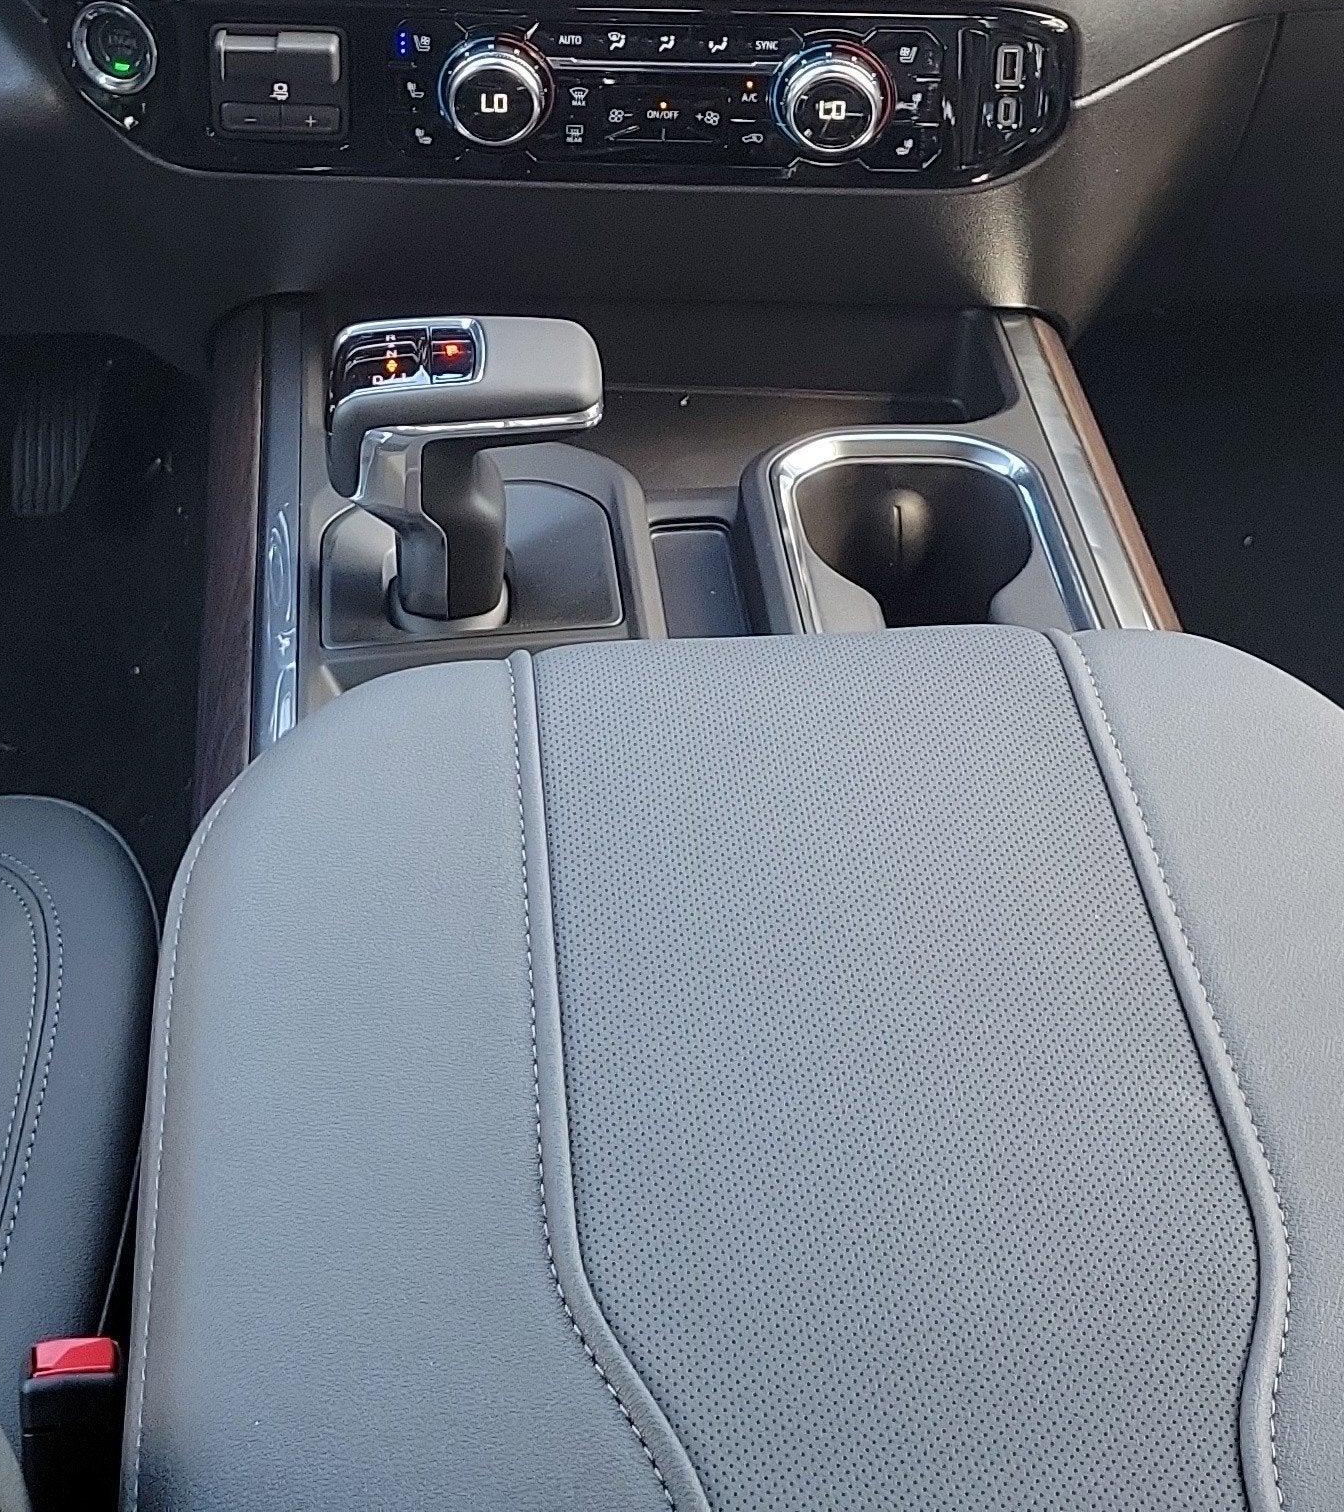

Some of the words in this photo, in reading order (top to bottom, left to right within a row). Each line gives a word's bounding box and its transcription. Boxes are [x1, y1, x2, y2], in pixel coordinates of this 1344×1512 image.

[559, 35, 583, 45] AUTO
[755, 41, 778, 51] SYNC
[481, 93, 508, 113] LO
[741, 93, 758, 103] A/C
[647, 110, 679, 119] ON/OFF
[446, 345, 458, 356] P
